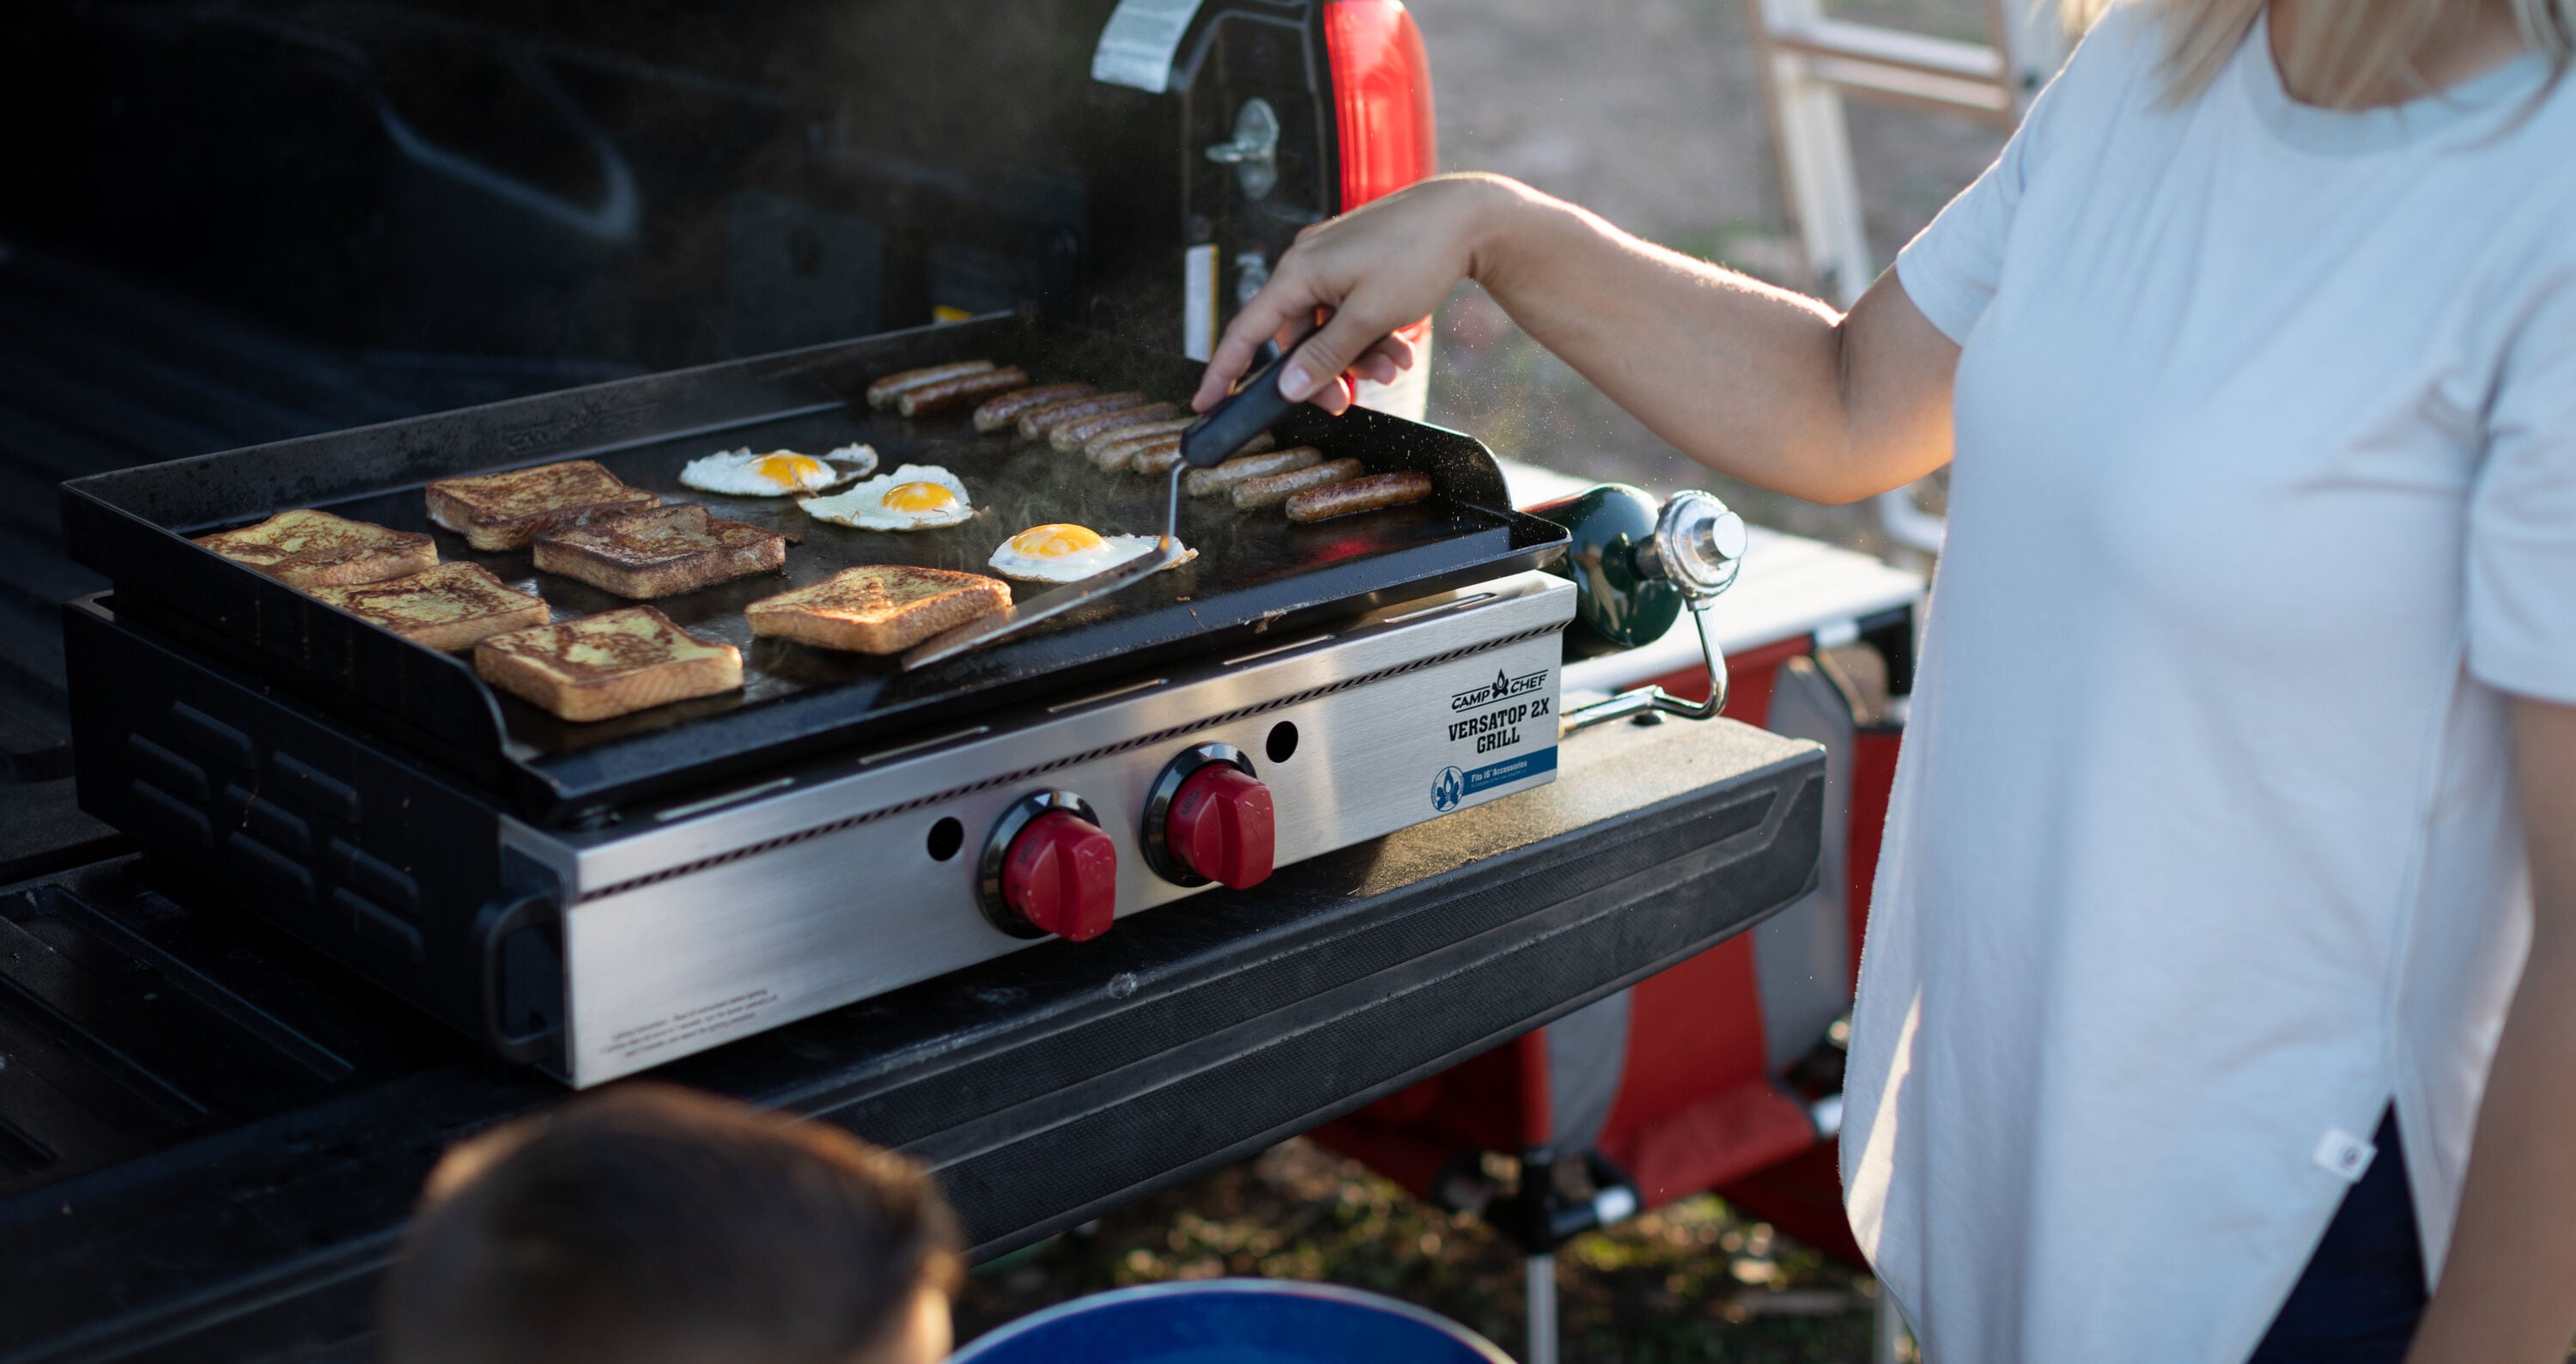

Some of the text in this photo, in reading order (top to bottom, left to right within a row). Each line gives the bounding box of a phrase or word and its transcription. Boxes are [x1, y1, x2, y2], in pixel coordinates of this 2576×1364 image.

[1451, 674, 1546, 710] CAMP CHEF
[1448, 697, 1550, 742] VERSATOP 2X
[1476, 727, 1521, 754] GRILL
[1471, 773, 1483, 782] Fits
[1492, 760, 1528, 777] Accessories
[1181, 789, 1200, 817] MED
